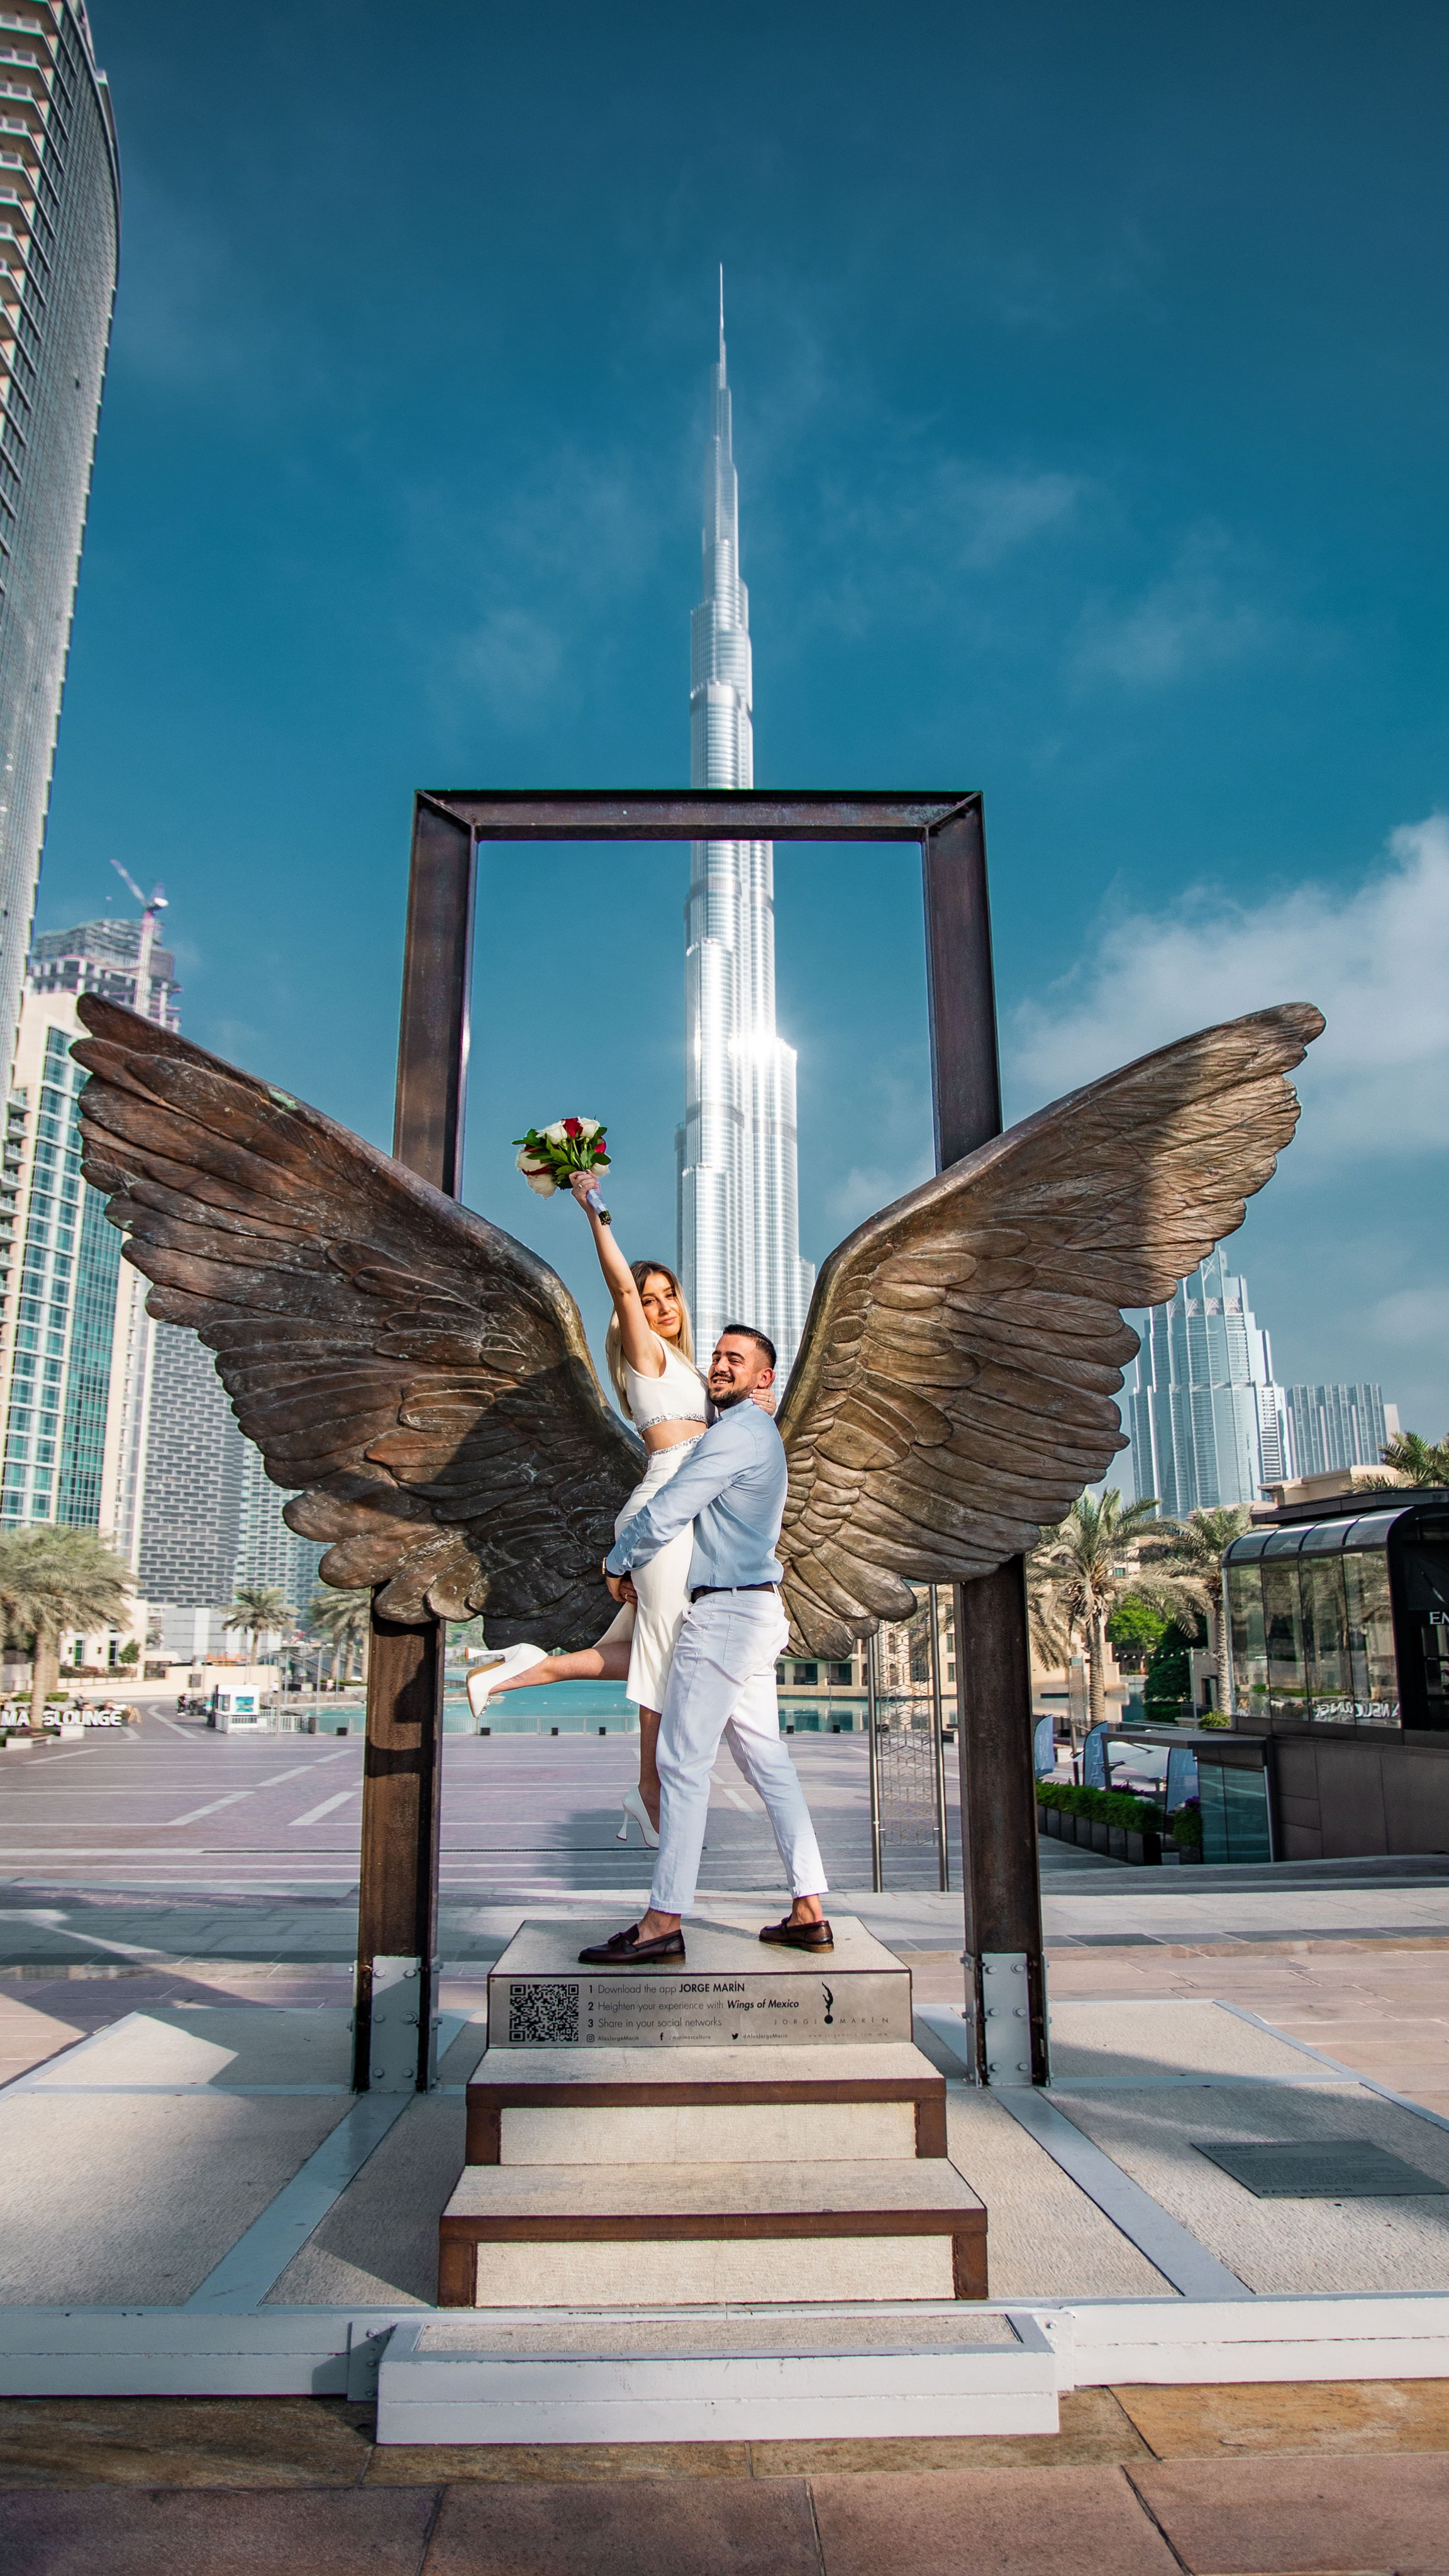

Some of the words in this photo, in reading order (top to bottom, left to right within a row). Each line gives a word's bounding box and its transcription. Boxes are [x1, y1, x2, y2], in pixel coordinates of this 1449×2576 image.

[589, 1984, 592, 1994] 1
[598, 1984, 641, 1994] Download
[644, 1984, 657, 1993] the
[659, 1986, 677, 1995] app
[679, 1983, 710, 1993] JORGE
[713, 1981, 745, 1992] MARÍN
[588, 2002, 594, 2011] 2
[598, 2001, 635, 2012] Heighten
[638, 2002, 655, 2012] your
[658, 2001, 704, 2012] experience
[707, 2000, 723, 2009] with
[727, 2000, 754, 2011] Wings
[757, 1999, 767, 2008] of
[768, 1999, 799, 2008] Mexico
[588, 2019, 594, 2028] 3
[598, 2018, 623, 2028] Share
[626, 2019, 633, 2028] in
[636, 2020, 654, 2029] your
[657, 2017, 682, 2027] social
[685, 2016, 722, 2026] networks
